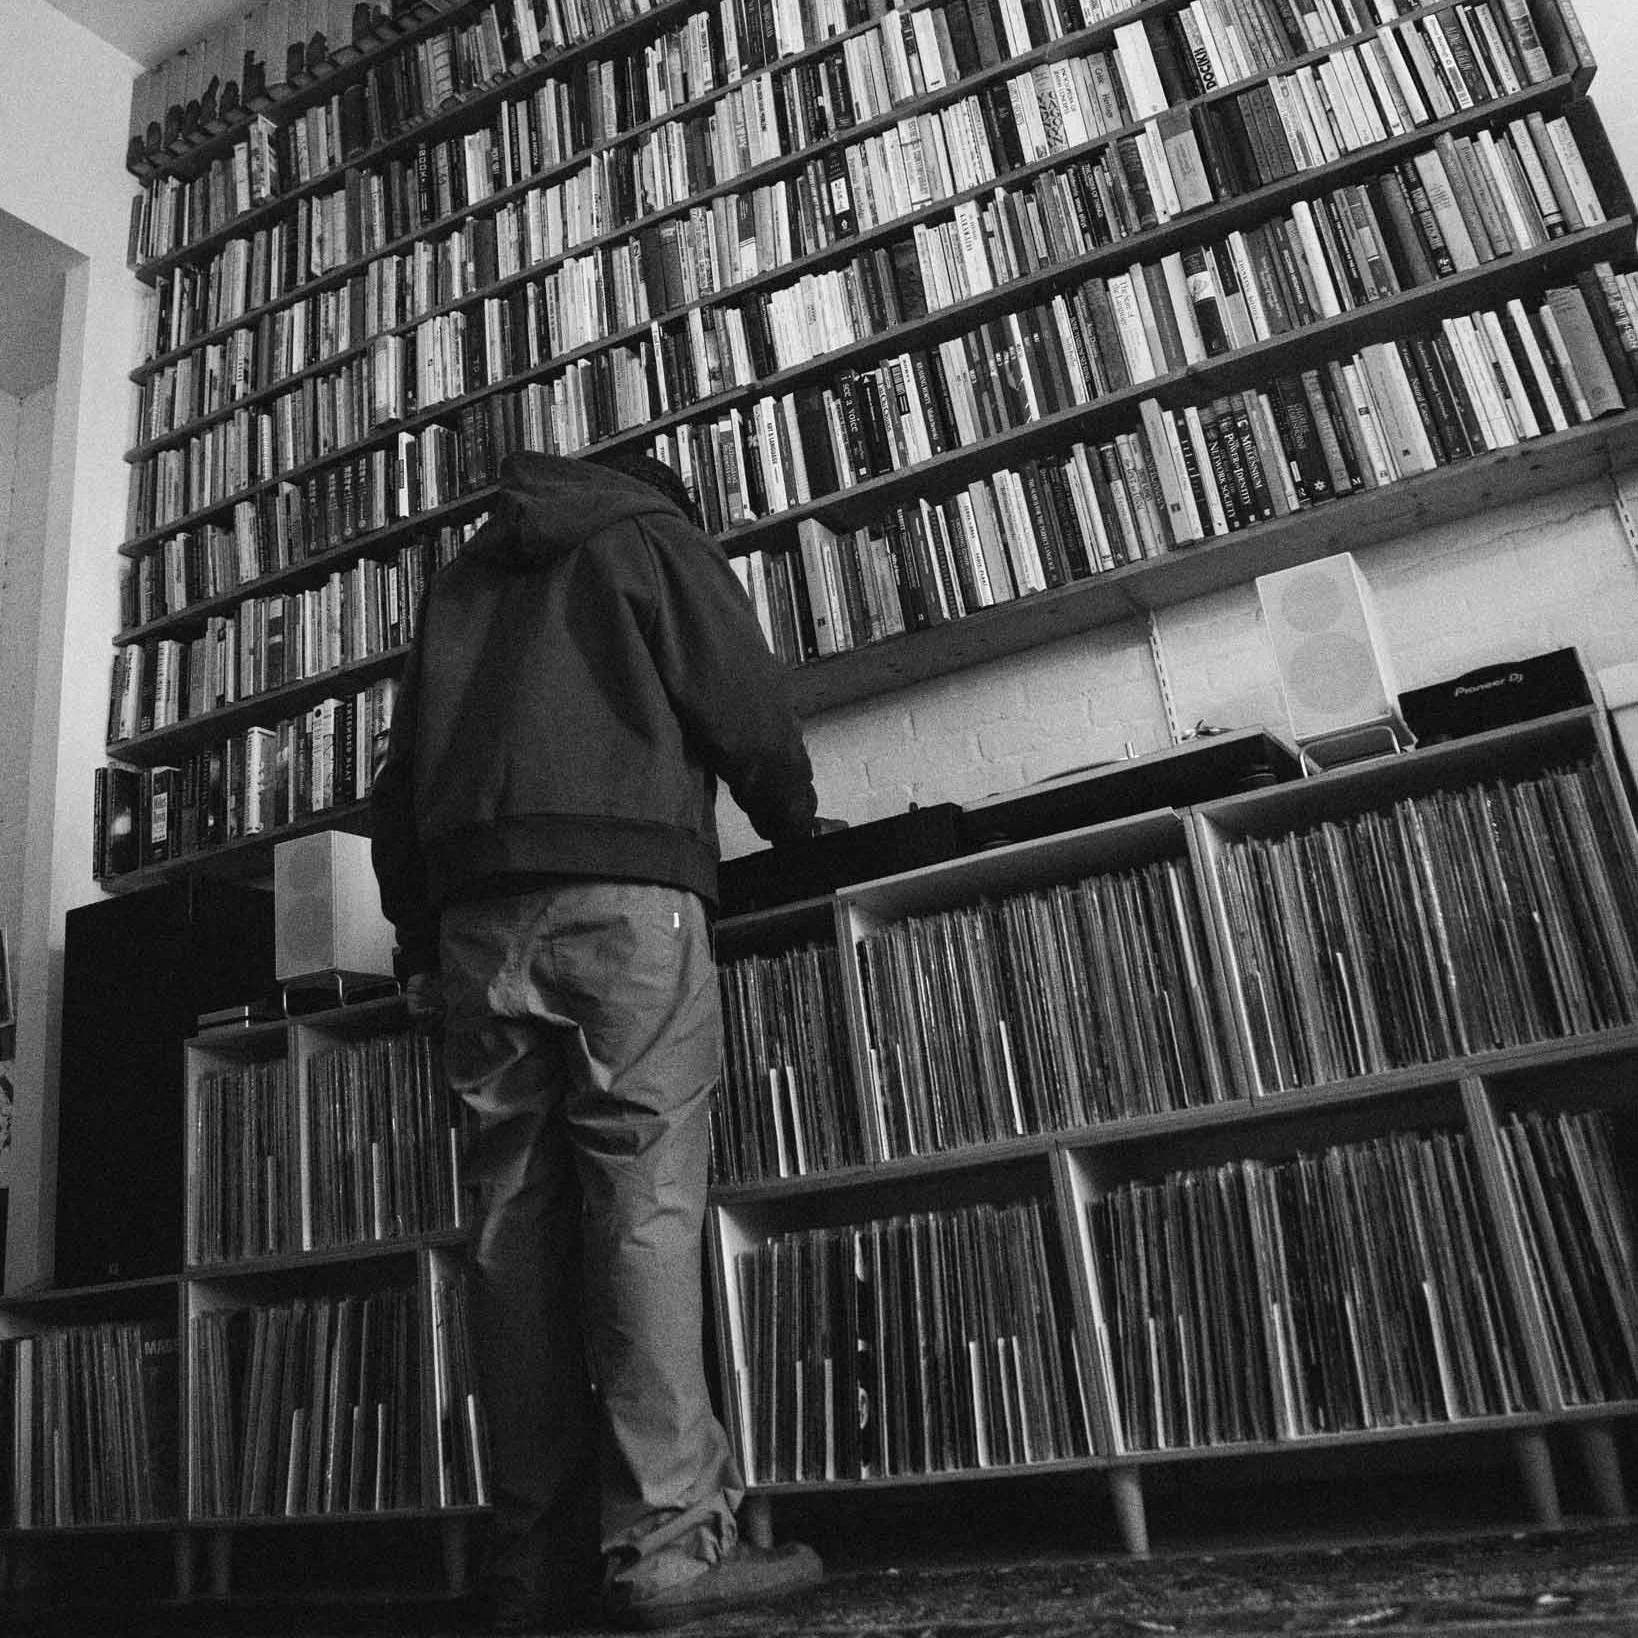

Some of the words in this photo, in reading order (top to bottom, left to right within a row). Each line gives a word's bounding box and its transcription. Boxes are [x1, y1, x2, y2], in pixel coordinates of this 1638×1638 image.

[841, 382, 851, 397] see
[846, 407, 862, 432] voice
[767, 436, 778, 464] LANGUAGE
[1222, 432, 1241, 463] POWER
[1232, 467, 1253, 505] IDENTITY
[1239, 433, 1265, 489] MILLENNIUM
[1207, 440, 1229, 483] NETWORK
[1218, 483, 1237, 518] SOCIETY
[1454, 677, 1506, 697] Pioneer
[1508, 673, 1525, 684] DJ
